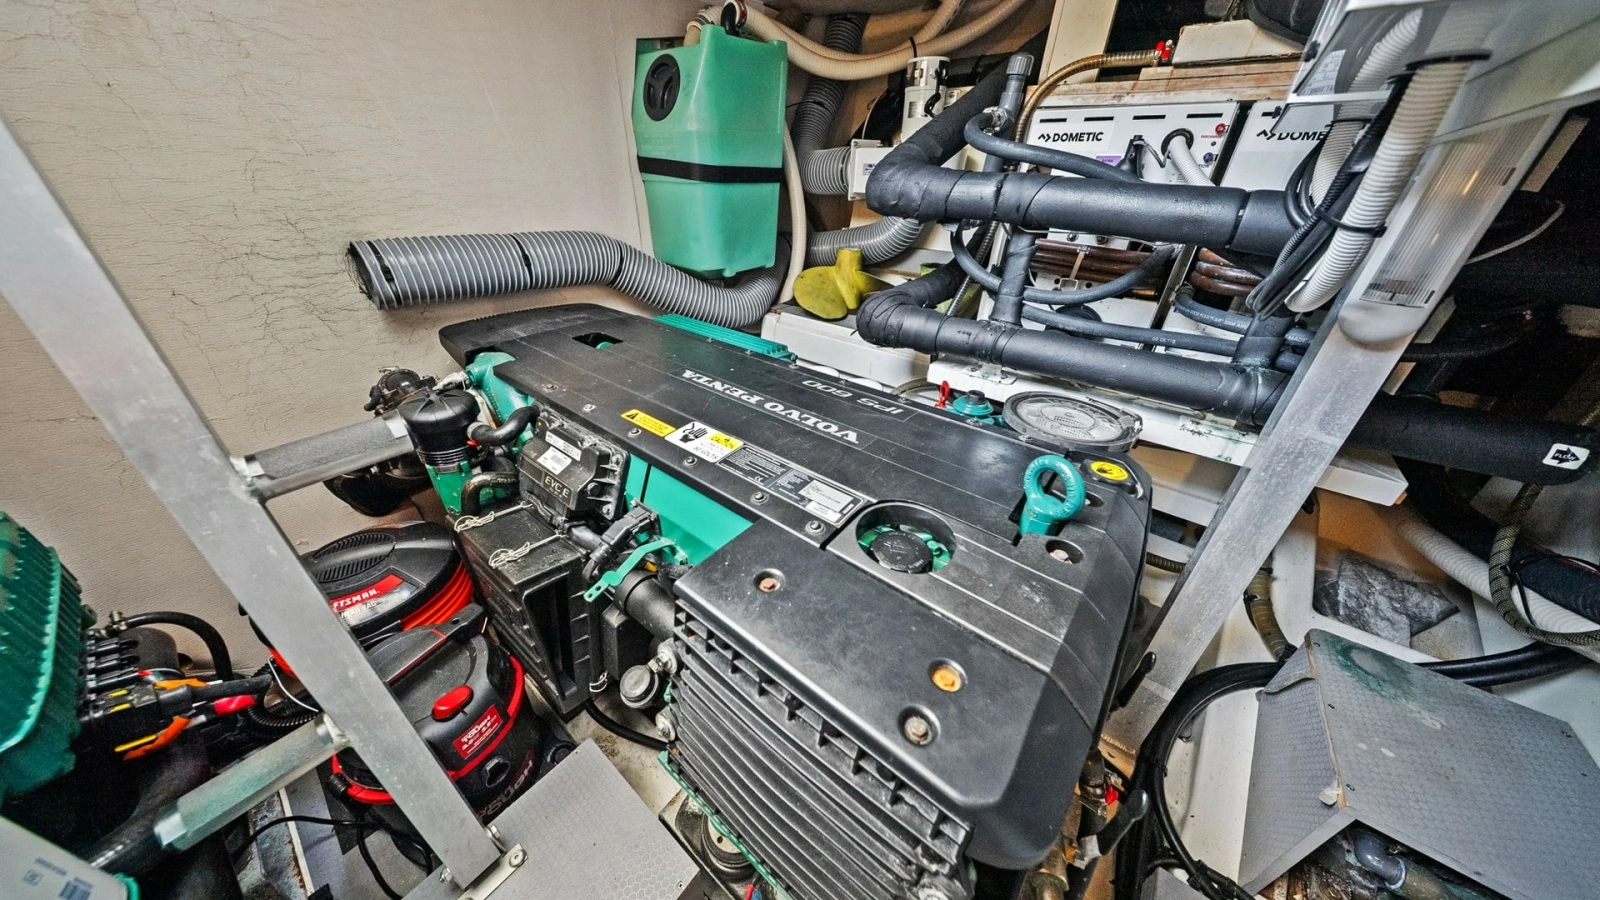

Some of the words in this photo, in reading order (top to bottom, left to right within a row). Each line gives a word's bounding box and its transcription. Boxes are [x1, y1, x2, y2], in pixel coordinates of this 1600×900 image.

[1052, 132, 1104, 142] DOMETIC
[1277, 130, 1328, 140] DOME
[681, 369, 765, 405] PENTA
[802, 380, 853, 399] 600
[857, 398, 904, 415] IPS
[764, 401, 860, 444] VOLVO
[545, 475, 562, 492] EVC
[562, 488, 571, 498] E
[332, 588, 378, 609] FTSMAN
